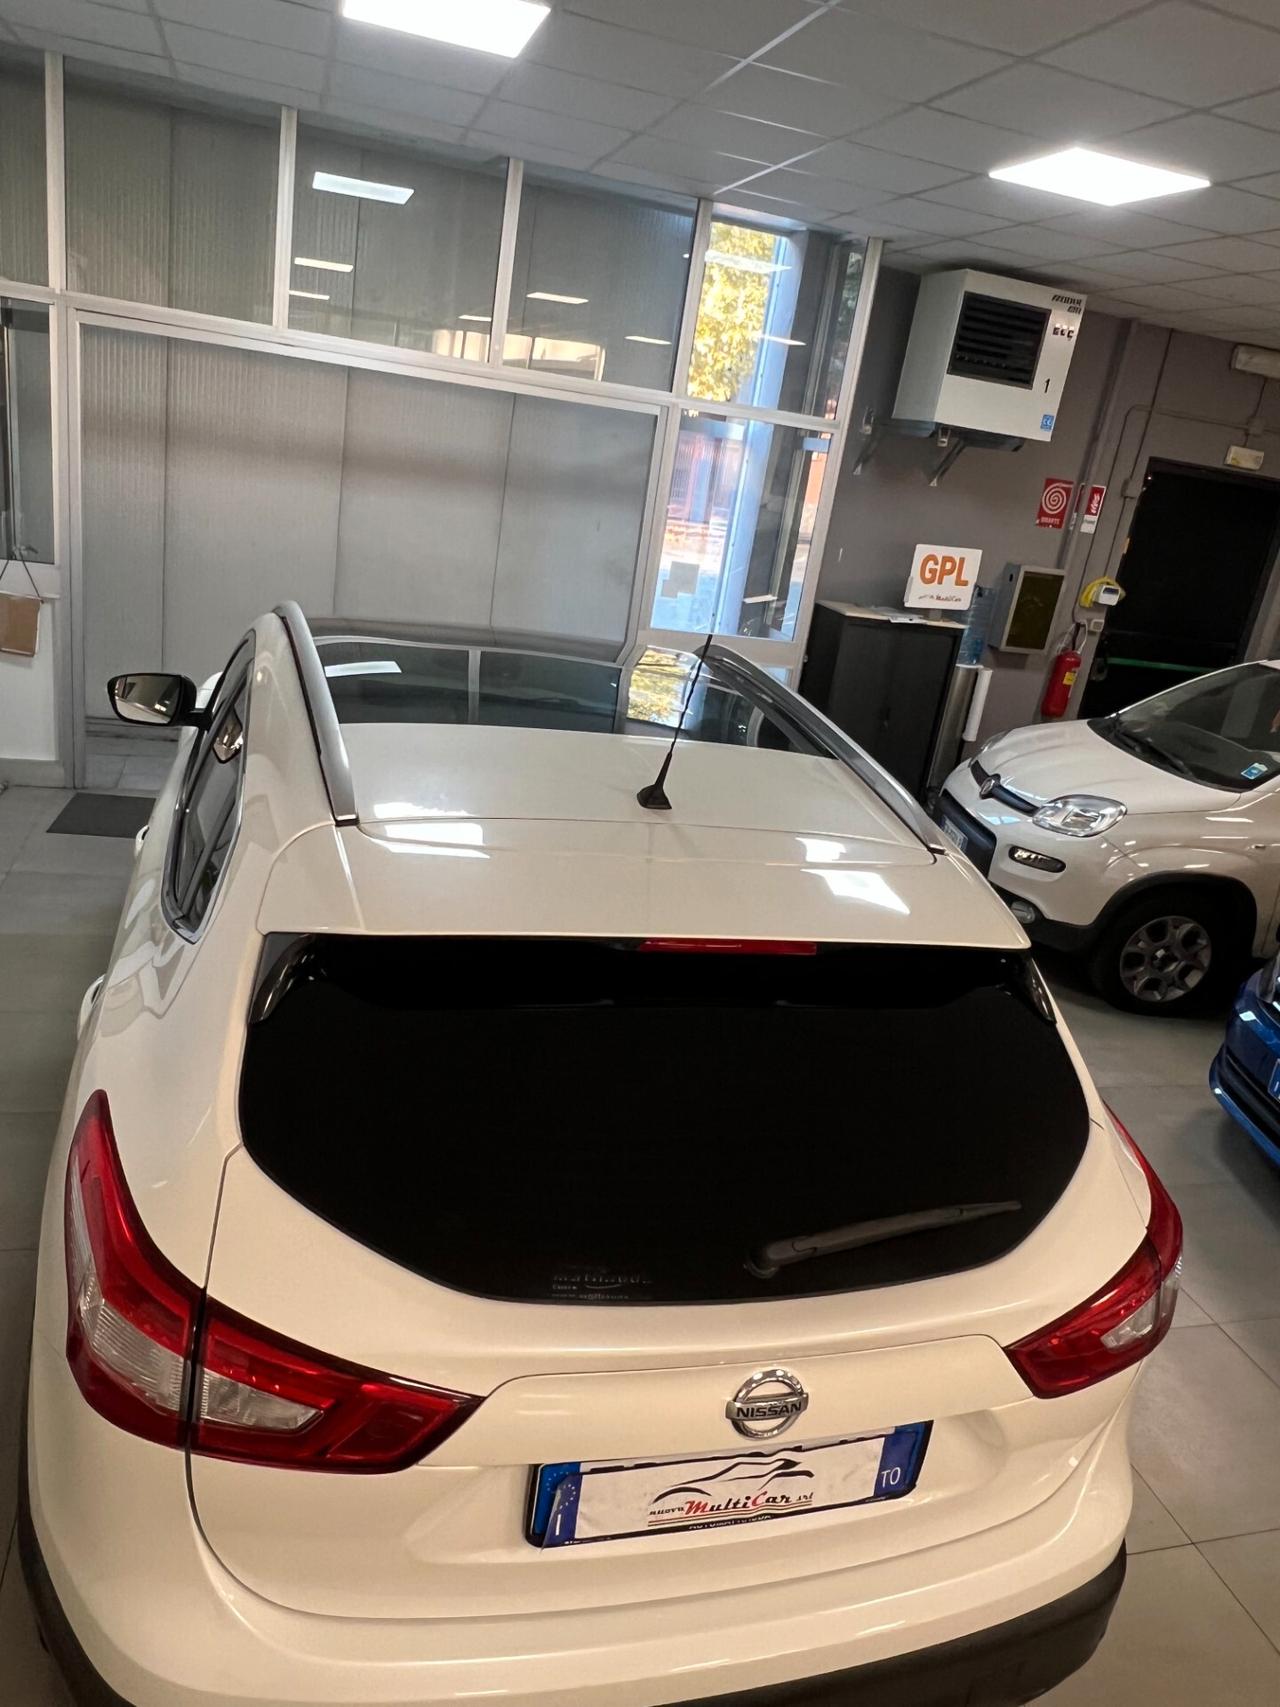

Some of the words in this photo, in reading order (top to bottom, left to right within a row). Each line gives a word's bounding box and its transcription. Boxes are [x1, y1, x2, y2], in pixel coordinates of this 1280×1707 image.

[1044, 378, 1051, 394] 1
[920, 553, 969, 587] GPL
[736, 1402, 802, 1419] NISSAN
[881, 1466, 901, 1488] TO
[684, 1490, 793, 1516] MultiCar
